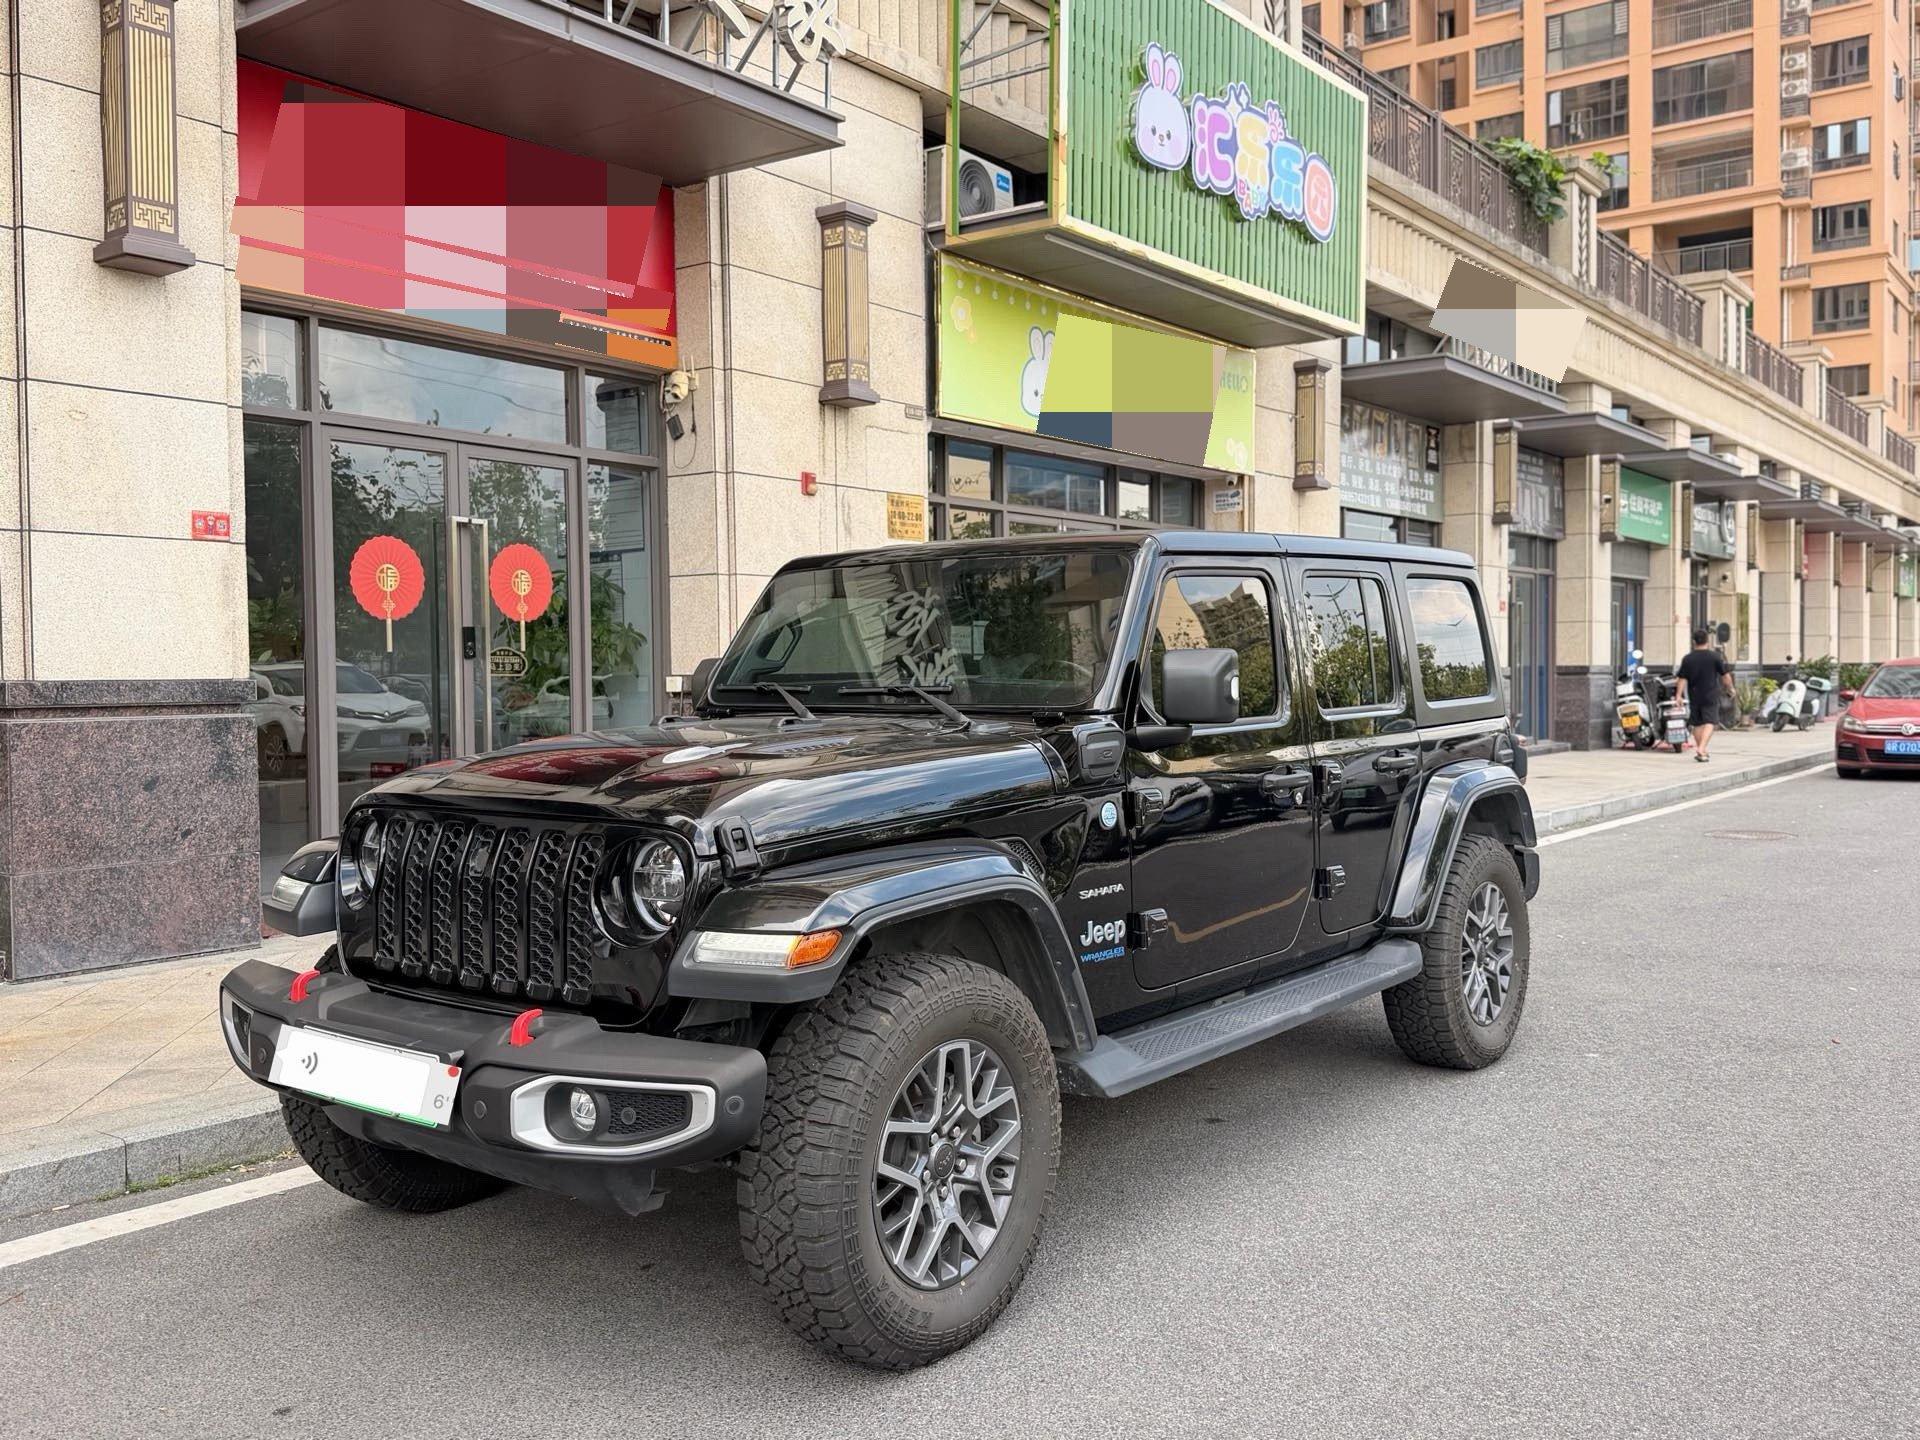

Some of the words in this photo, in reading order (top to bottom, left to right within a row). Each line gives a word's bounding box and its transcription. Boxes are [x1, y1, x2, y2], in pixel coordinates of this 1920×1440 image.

[1079, 883, 1125, 899] SAHARA
[1080, 919, 1126, 947] Jeep
[1080, 946, 1125, 962] WRANGLER
